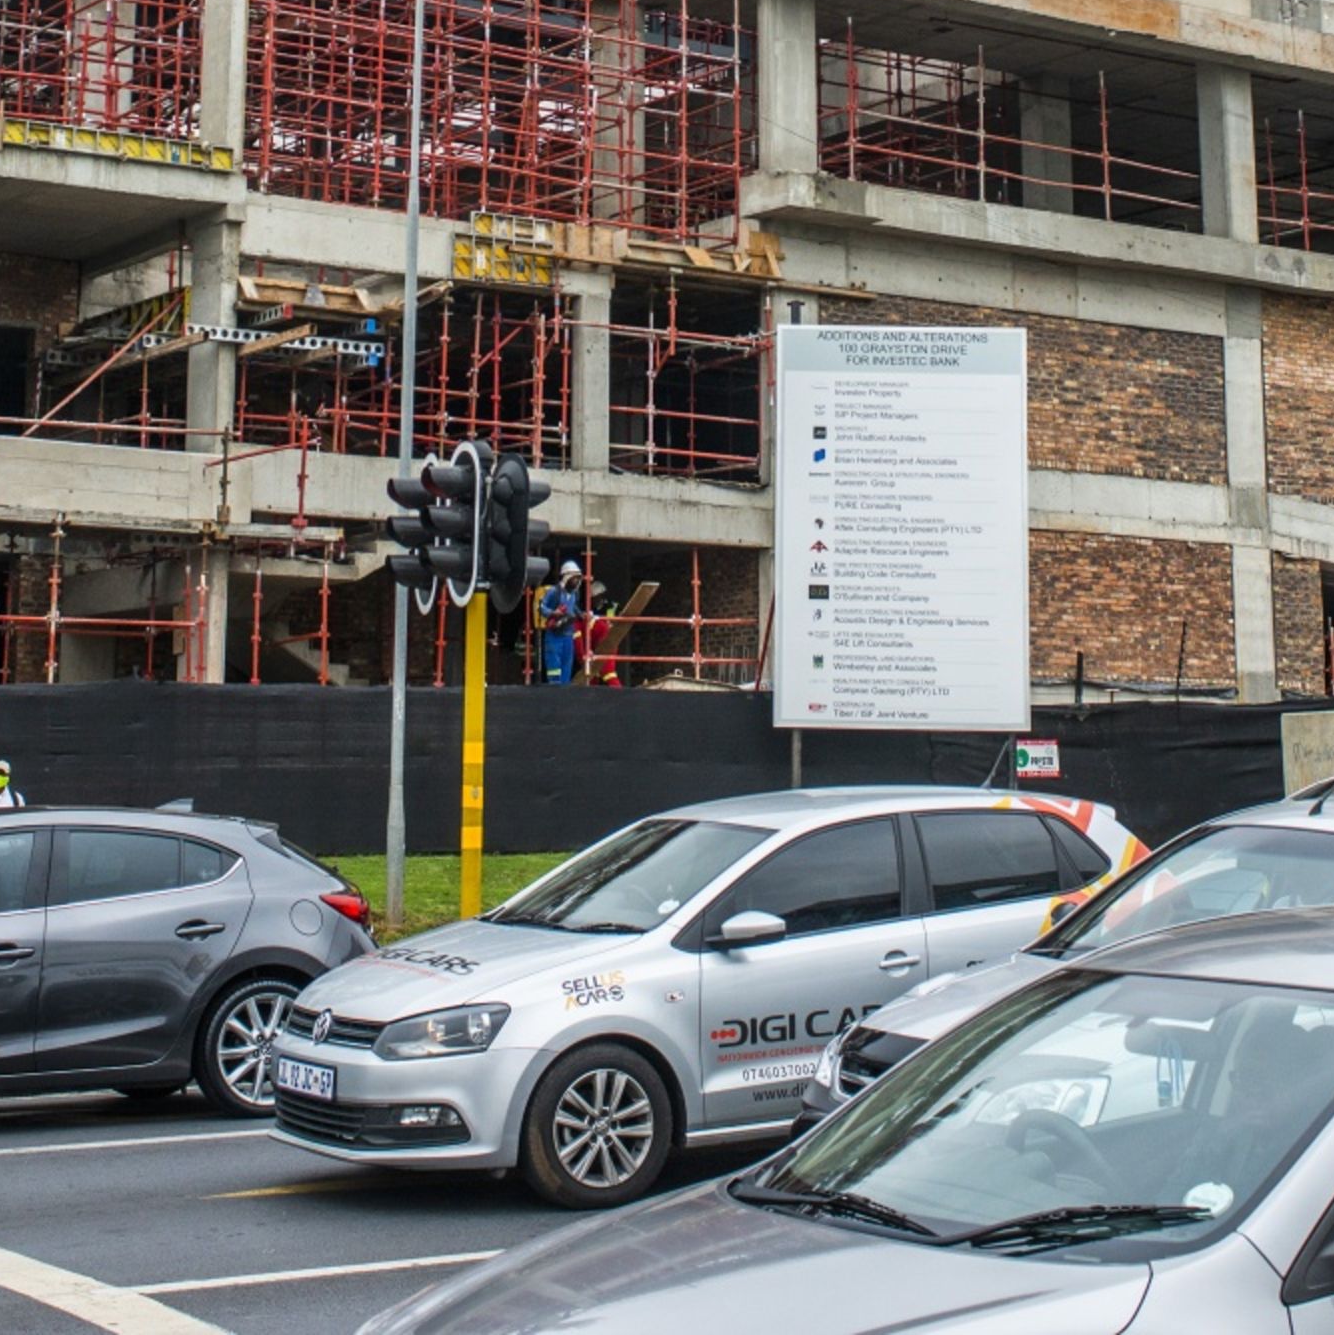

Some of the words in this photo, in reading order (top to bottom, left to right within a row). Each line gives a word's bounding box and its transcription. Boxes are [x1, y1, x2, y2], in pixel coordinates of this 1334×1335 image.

[817, 330, 880, 342] ADDITIONS
[882, 332, 907, 342] AND
[909, 332, 988, 344] ALTERATIONS
[838, 344, 858, 353] 100
[861, 344, 928, 354] GRAYSTON
[931, 344, 968, 355] DRIVE
[846, 355, 868, 365] FOR
[872, 356, 927, 366] INVESTEC
[930, 357, 960, 366] BANK
[868, 388, 902, 398] Property
[880, 412, 918, 420] Managers
[834, 433, 854, 442] John
[899, 457, 913, 465] and
[916, 458, 957, 466] Associates
[870, 479, 896, 488] Group
[860, 501, 902, 511] Consulting
[856, 524, 897, 534] Consulting
[899, 524, 939, 534] Engineers
[834, 547, 868, 556] Adaptive
[870, 547, 907, 556] Resource
[909, 548, 949, 557] Engineers
[834, 570, 865, 579] Building
[867, 570, 888, 578] Code
[890, 571, 936, 579] Consultants
[875, 593, 890, 601] and
[892, 594, 929, 603] Company
[833, 616, 866, 624] Acoustic
[868, 616, 898, 626] Design
[906, 618, 953, 627] Engineering
[867, 640, 913, 648] Consultants
[876, 663, 892, 671] and
[894, 664, 937, 672] Associates
[906, 687, 931, 697] (PTY)
[932, 688, 950, 696] LTD
[876, 710, 896, 719] Joint
[897, 711, 929, 719] Venture
[718, 1013, 795, 1048] DIGI
[752, 1084, 809, 1102] www.di
